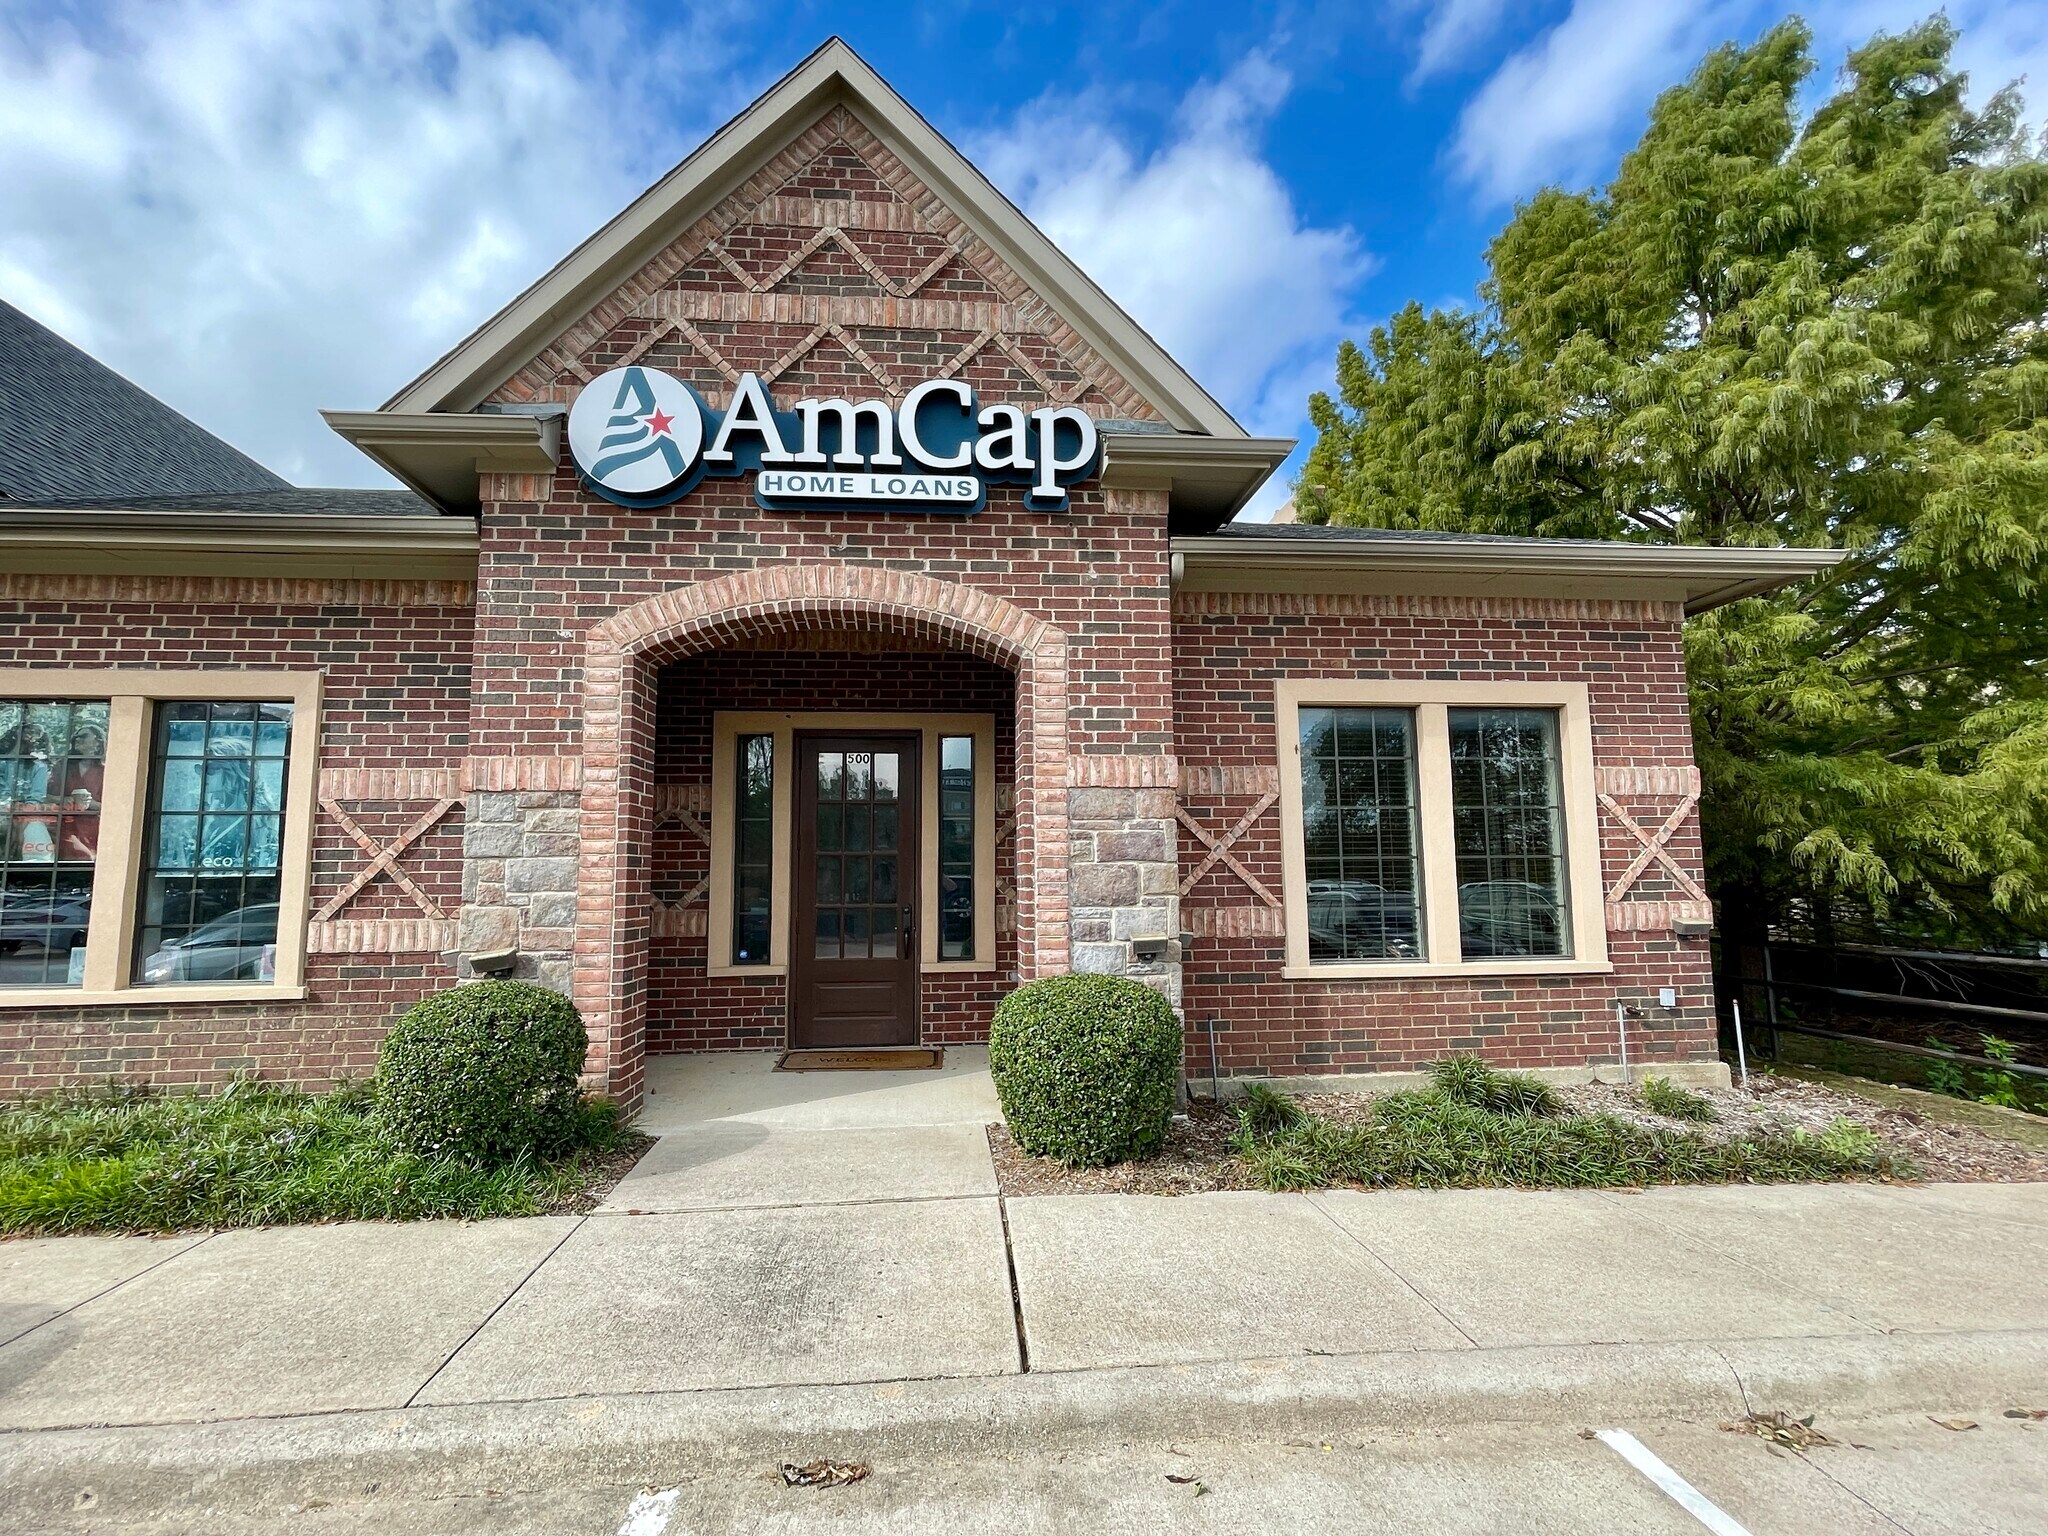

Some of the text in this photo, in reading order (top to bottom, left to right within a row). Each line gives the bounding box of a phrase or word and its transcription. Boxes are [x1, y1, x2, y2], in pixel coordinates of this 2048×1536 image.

[703, 372, 1097, 497] AmCap
[764, 475, 973, 497] HOME LOANS
[847, 753, 870, 764] 500
[202, 857, 233, 867] eco
